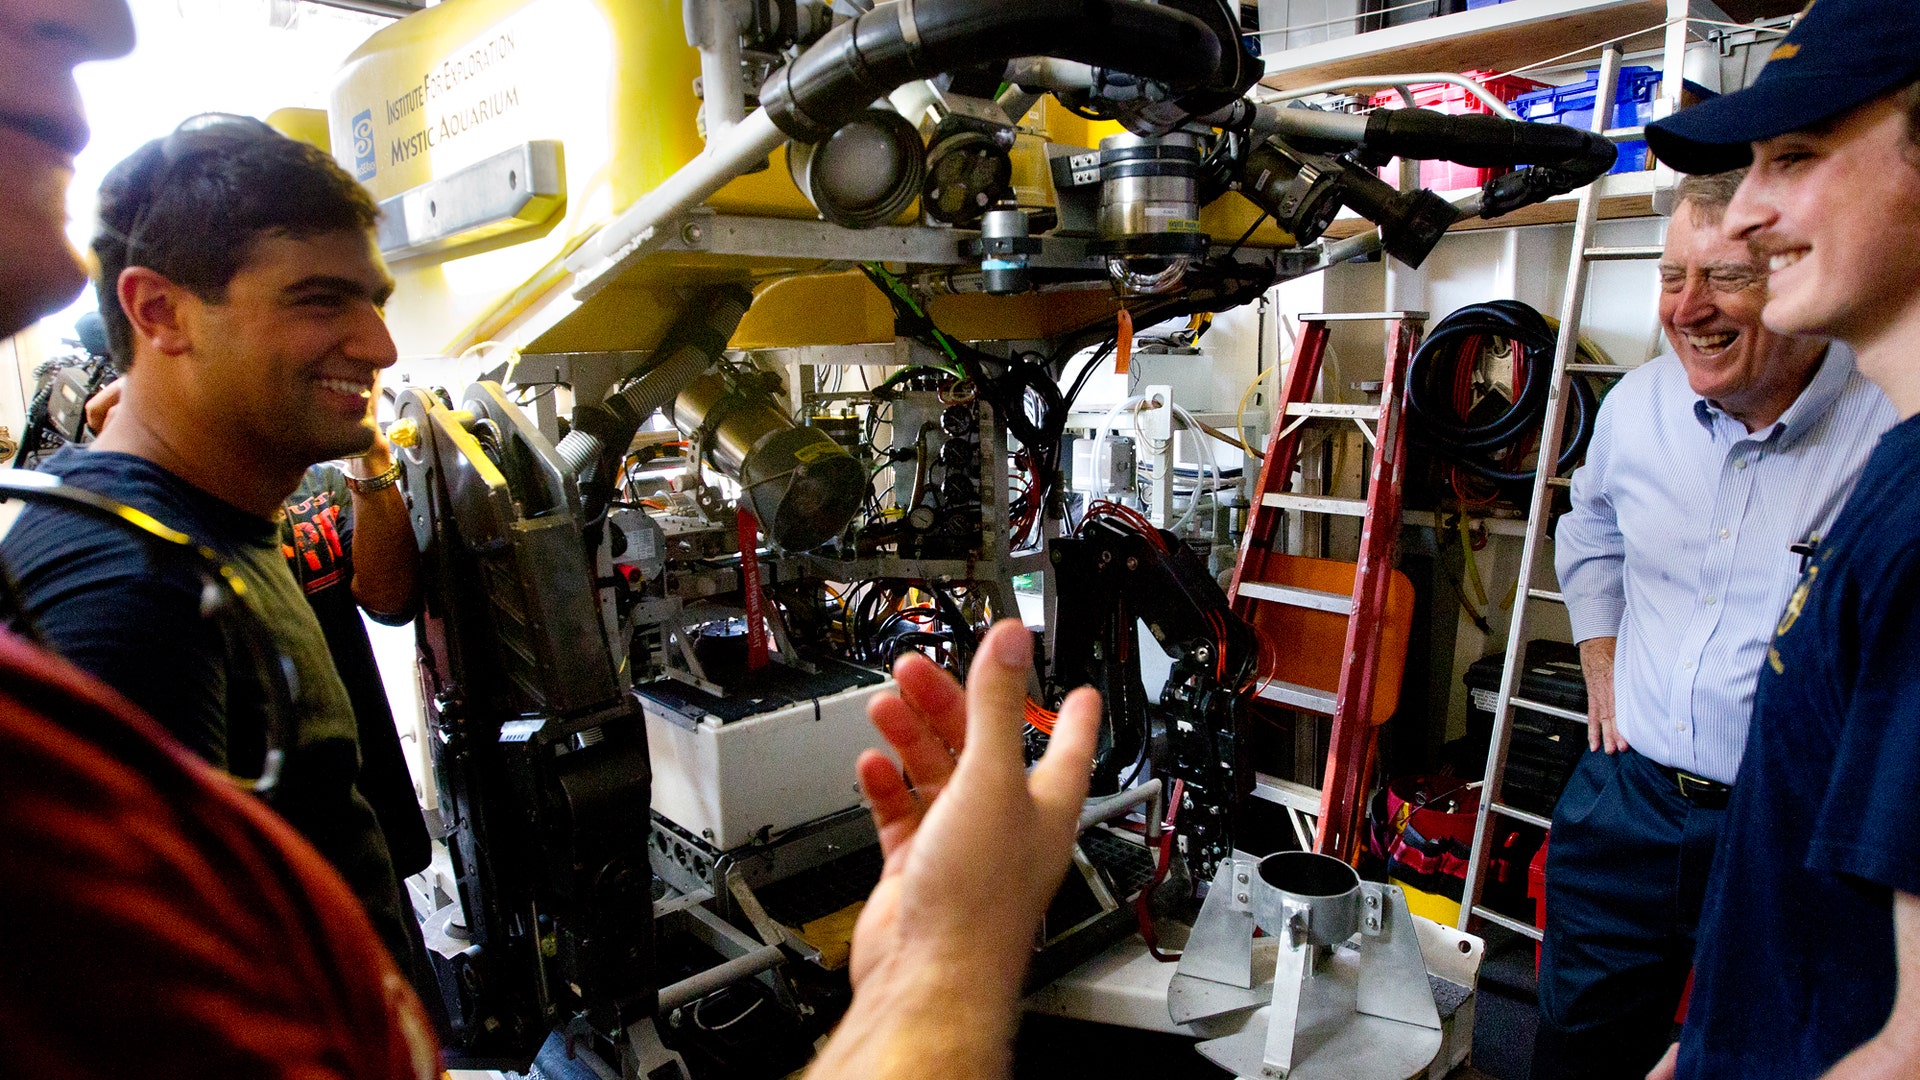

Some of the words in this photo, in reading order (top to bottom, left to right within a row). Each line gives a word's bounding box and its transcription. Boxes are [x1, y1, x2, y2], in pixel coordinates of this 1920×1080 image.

[386, 86, 424, 125] INSTITUTE
[424, 74, 443, 103] FOR
[444, 32, 516, 91] EXPLORATION
[391, 127, 435, 167] MYSTIC
[748, 571, 759, 612] BEFORE
[752, 612, 762, 648] FLIGHT
